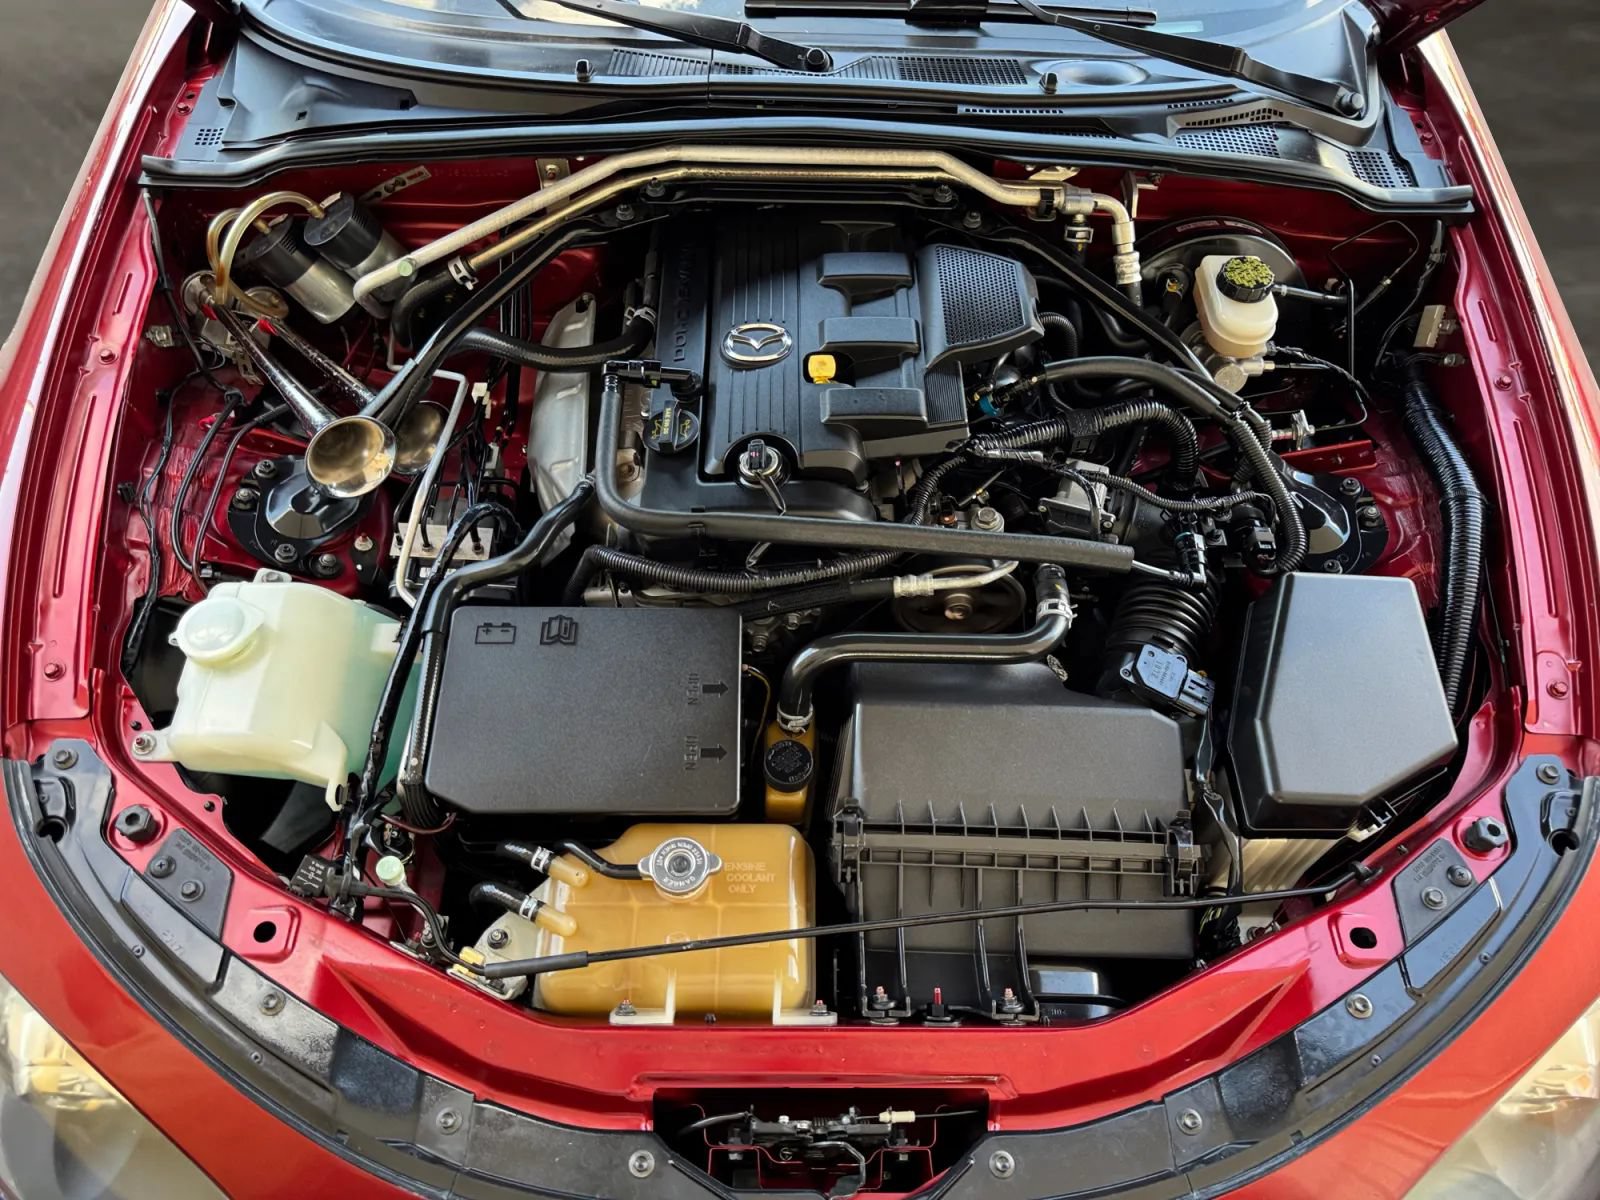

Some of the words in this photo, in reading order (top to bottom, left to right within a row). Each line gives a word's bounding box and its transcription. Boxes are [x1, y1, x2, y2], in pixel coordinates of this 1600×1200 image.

[664, 407, 672, 419] SAE
[687, 672, 699, 706] OPEN
[684, 735, 698, 771] OPEN
[724, 861, 767, 871] ENGINE
[663, 875, 696, 888] DANGER
[726, 872, 776, 883] COOLANT
[728, 883, 757, 893] ONLY
